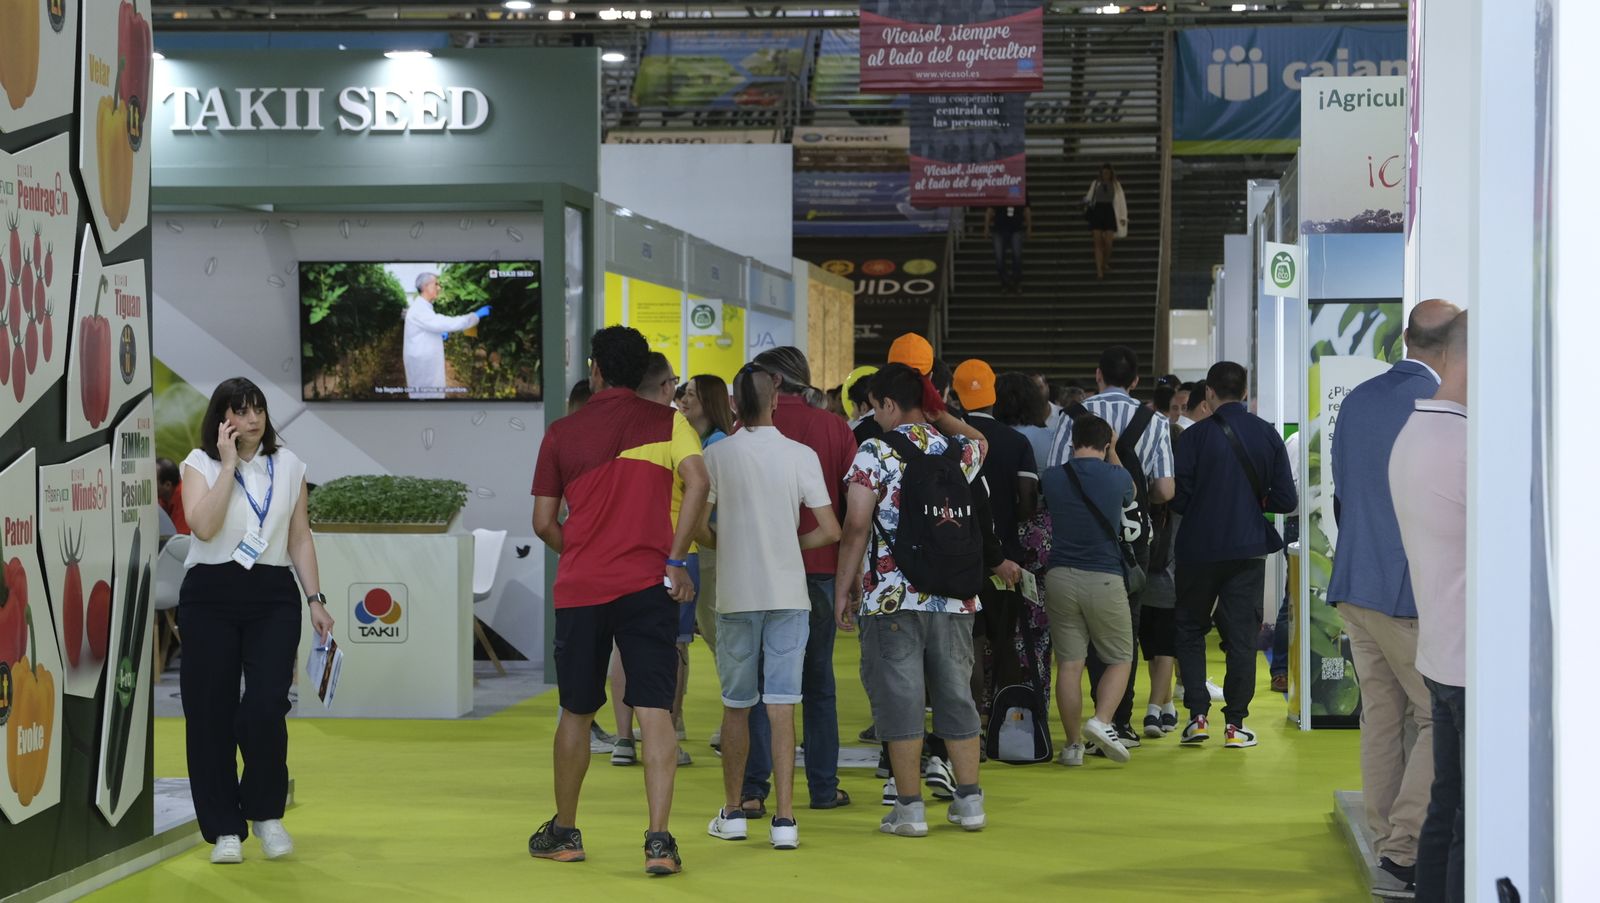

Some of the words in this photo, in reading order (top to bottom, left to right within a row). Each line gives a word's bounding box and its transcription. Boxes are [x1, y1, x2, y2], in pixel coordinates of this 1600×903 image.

[882, 24, 946, 45] Vicasol,
[949, 24, 1011, 45] siempre
[867, 48, 886, 67] al
[888, 48, 924, 66] lado
[927, 46, 954, 64] del
[956, 42, 1037, 69] agricultor
[88, 53, 111, 88] Velar
[915, 70, 981, 79] www.vicasol.es
[164, 86, 325, 132] TAKII
[337, 86, 491, 132] SEED
[928, 94, 947, 104] una
[949, 92, 1005, 106] cooperativa
[936, 104, 984, 116] centrada
[986, 106, 1001, 116] en
[1318, 87, 1407, 112] ¡Agricul
[932, 116, 948, 128] las
[824, 133, 889, 143] Cepacet
[923, 163, 965, 178] Vicasol,
[966, 162, 1006, 177] siempre
[17, 171, 69, 217] Pendragon
[914, 179, 927, 191] al
[928, 177, 951, 190] lado
[952, 176, 969, 189] del
[970, 174, 1023, 192] agricultor
[114, 288, 141, 320] Tiguan
[71, 468, 108, 512] Windsor
[5, 515, 33, 547] Patrol
[357, 626, 399, 637] TAKII
[17, 721, 44, 756] Evoke
